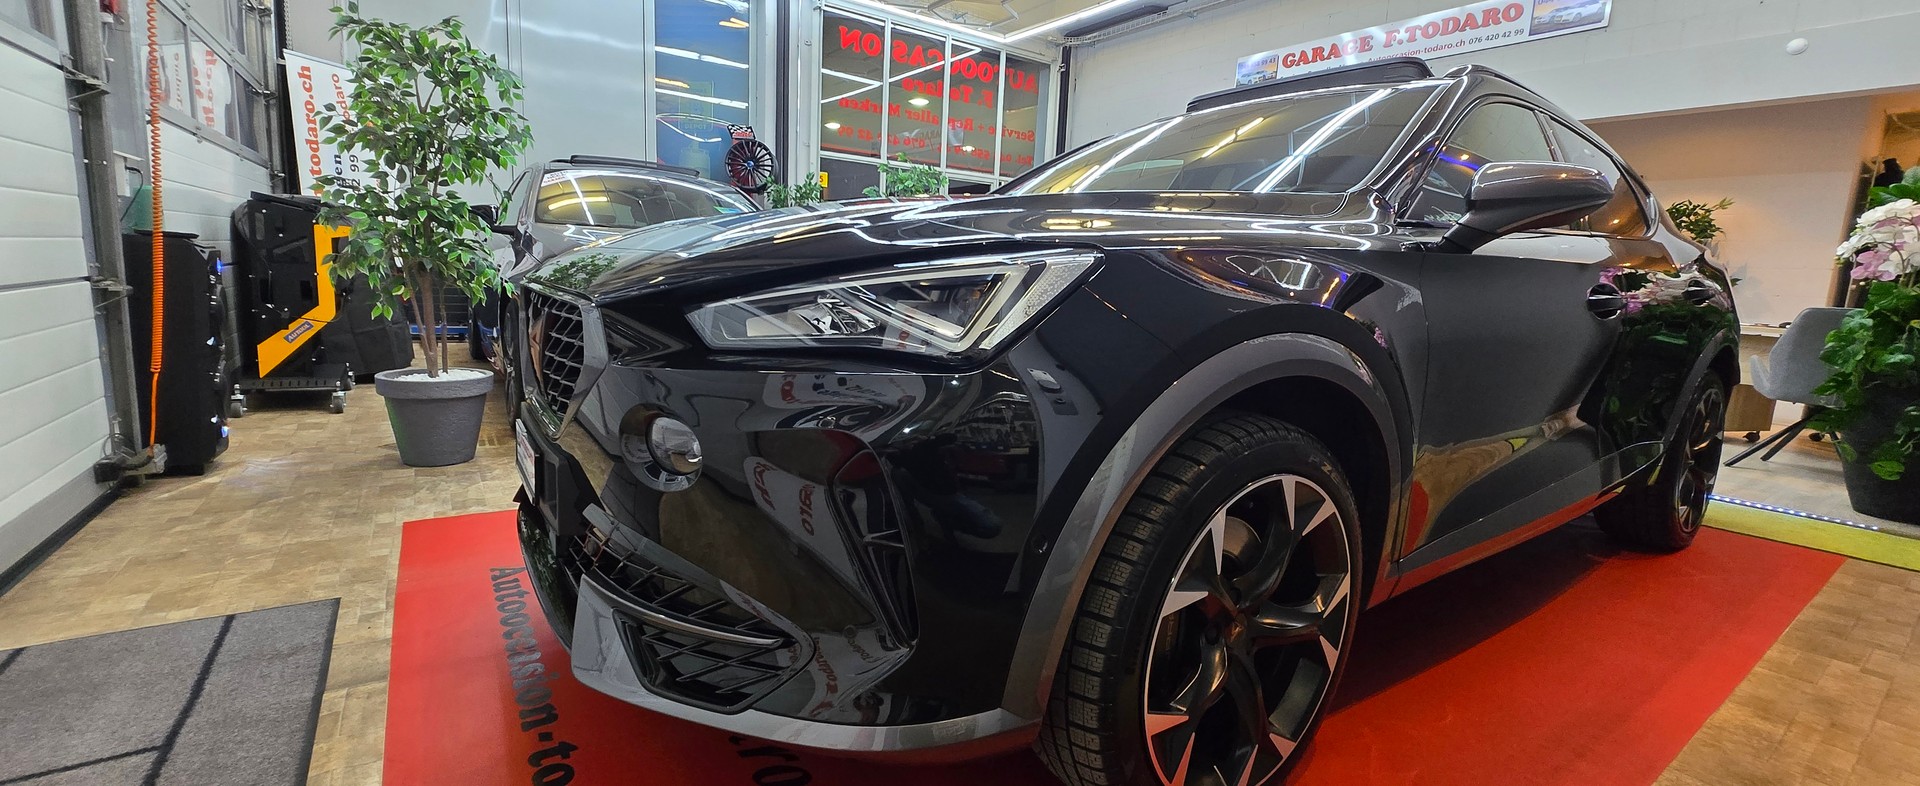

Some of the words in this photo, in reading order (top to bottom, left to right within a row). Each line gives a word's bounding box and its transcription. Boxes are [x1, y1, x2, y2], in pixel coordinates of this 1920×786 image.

[1468, 37, 1484, 46] 076
[1485, 33, 1500, 43] 420
[1501, 31, 1513, 40] 42
[1513, 28, 1525, 37] 99
[1282, 35, 1373, 68] GARAGE
[331, 73, 350, 122] odaro
[350, 154, 360, 173] 99
